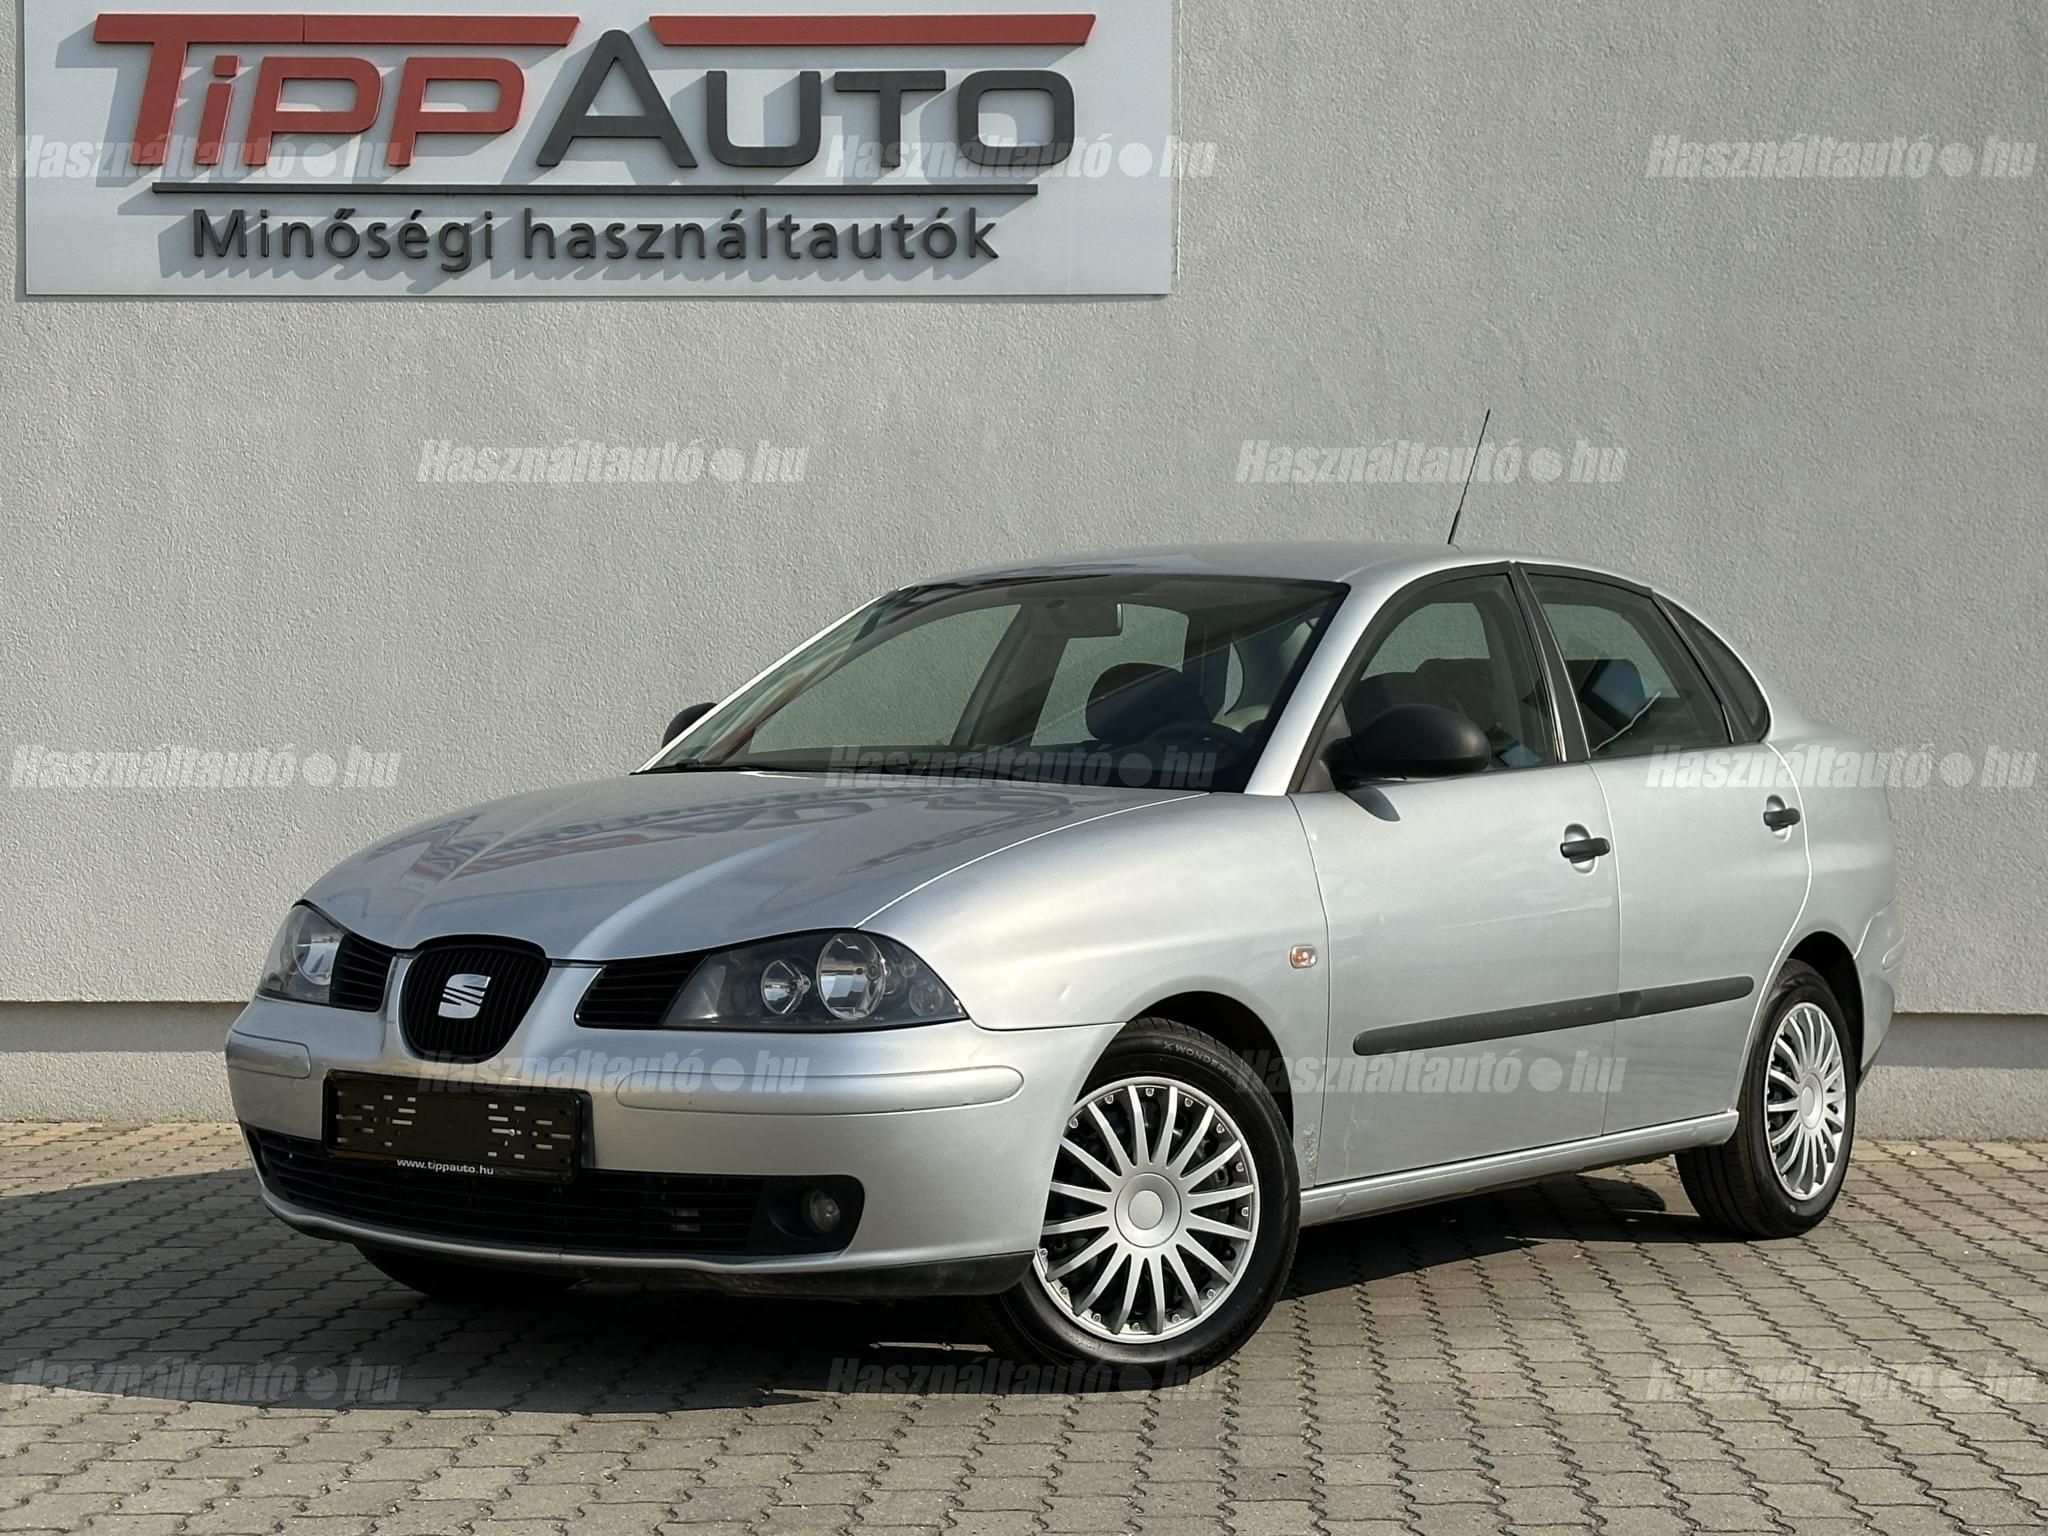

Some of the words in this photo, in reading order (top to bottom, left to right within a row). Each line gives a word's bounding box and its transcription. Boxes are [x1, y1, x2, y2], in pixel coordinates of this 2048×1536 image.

[193, 208, 495, 272] Minőségi
[523, 207, 999, 260] használtautók
[396, 1159, 494, 1175] www.tippauto.hu
